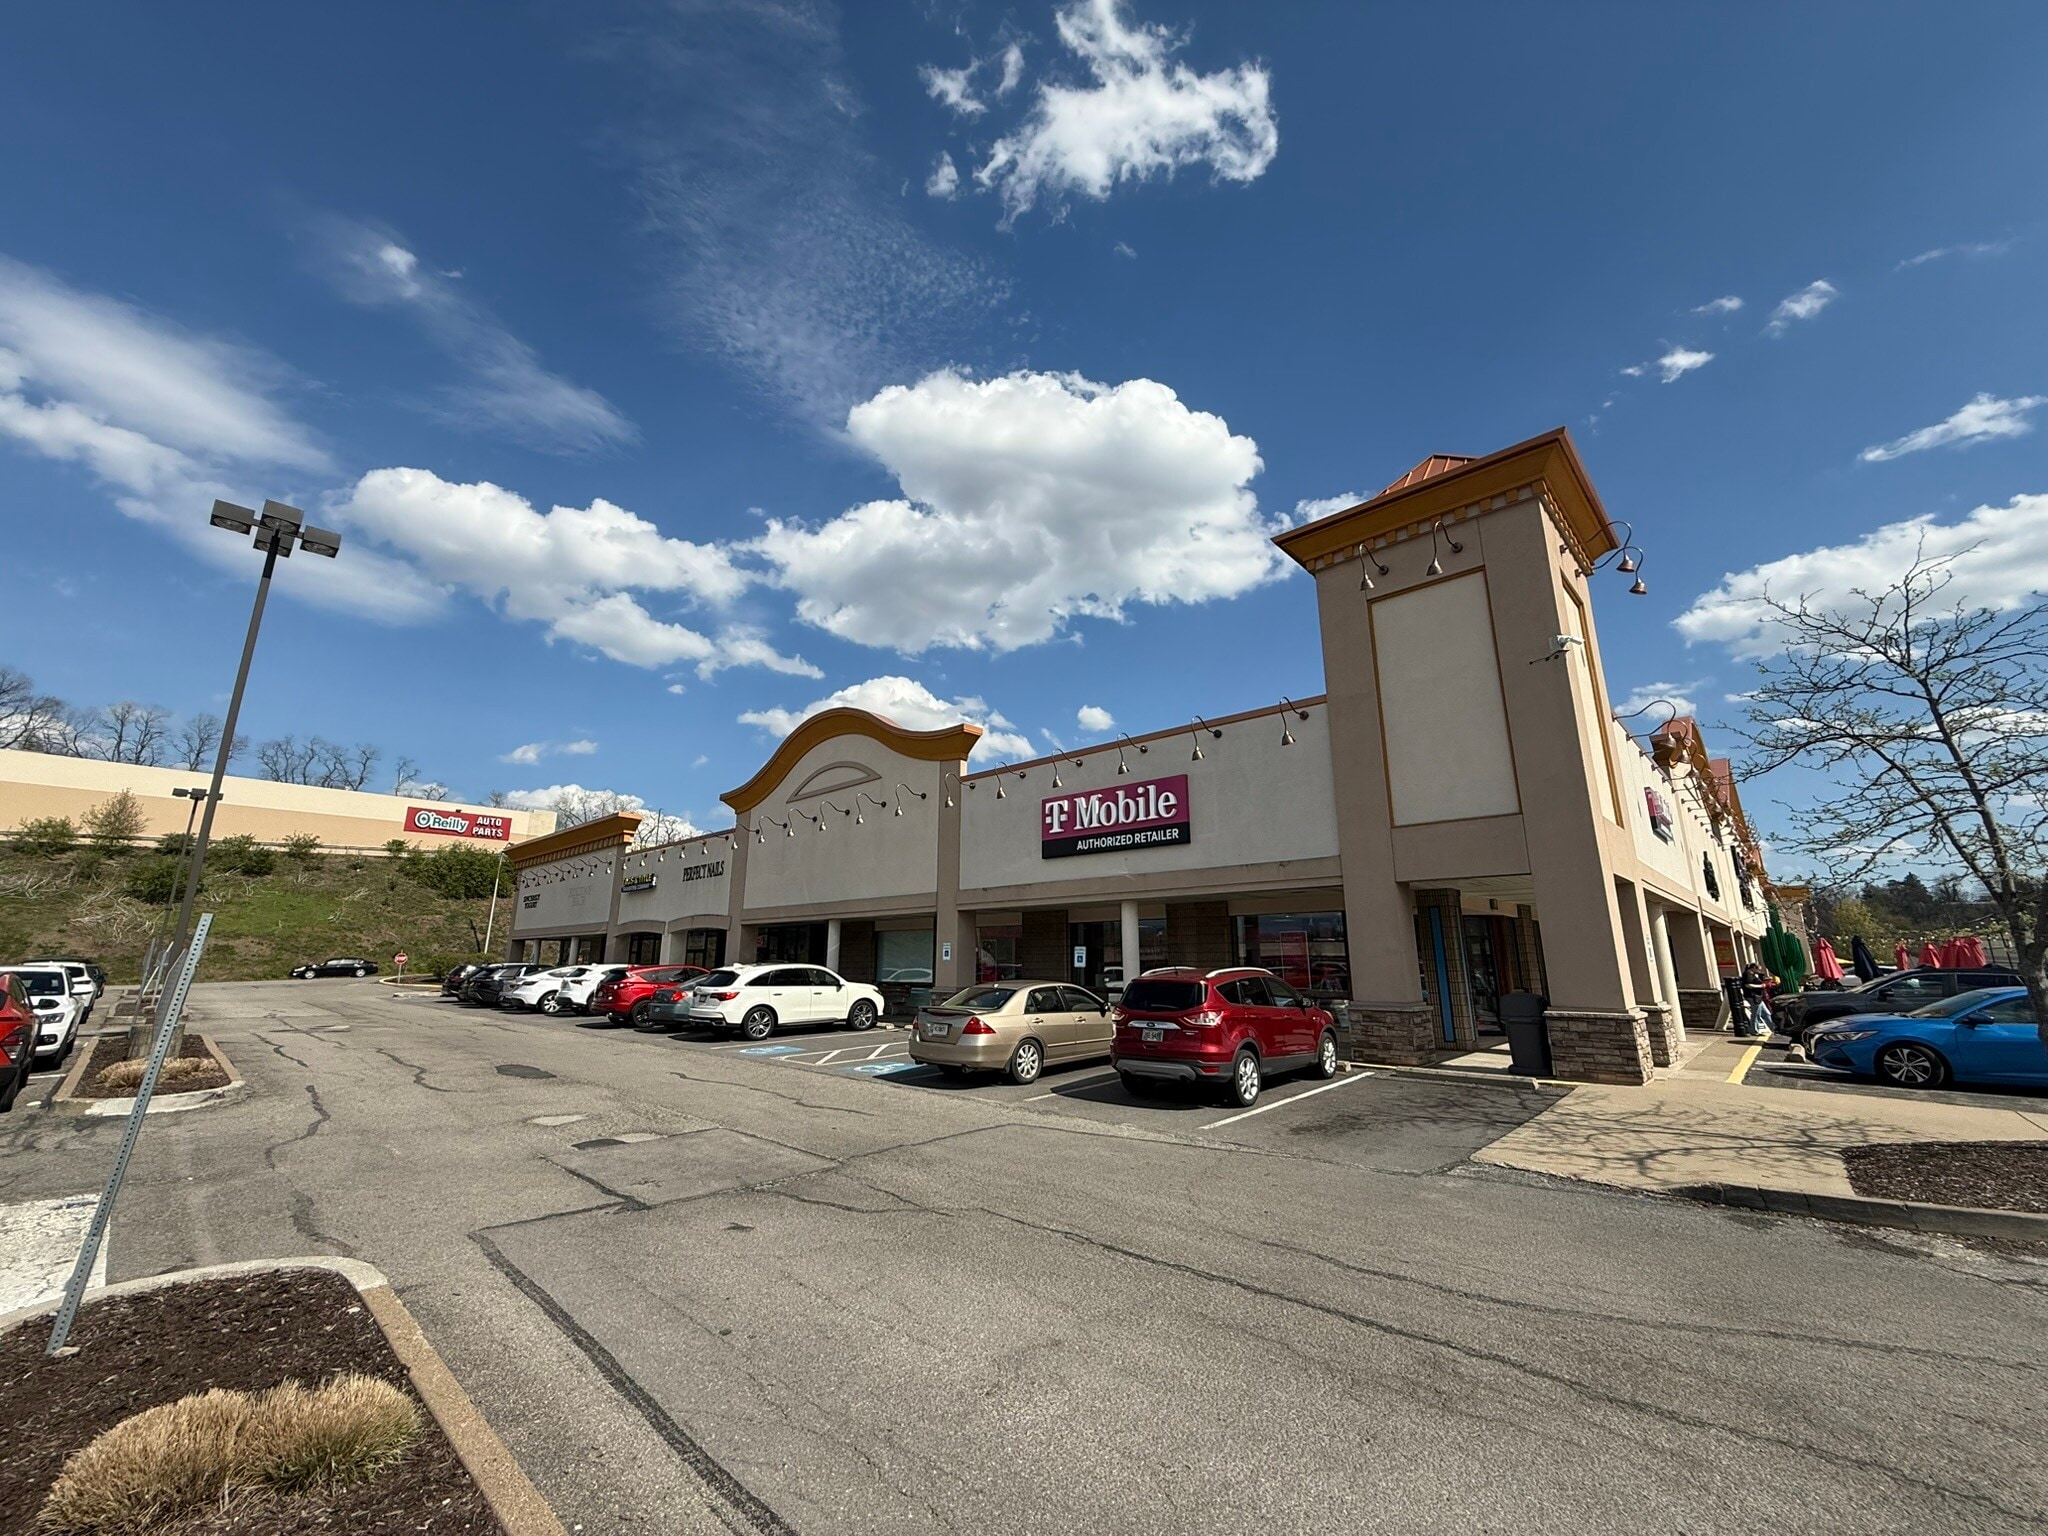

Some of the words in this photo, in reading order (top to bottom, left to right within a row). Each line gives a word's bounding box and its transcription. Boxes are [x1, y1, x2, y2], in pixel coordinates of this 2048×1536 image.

[1073, 784, 1178, 831] Mobile
[415, 811, 469, 833] O'Reilly
[472, 826, 503, 837] PARTS
[476, 816, 502, 827] AUTO
[1076, 833, 1134, 851] AUTHORIZED
[1134, 828, 1180, 844] RETAILER
[682, 864, 707, 882] PERFECT
[706, 860, 725, 878] NAILS
